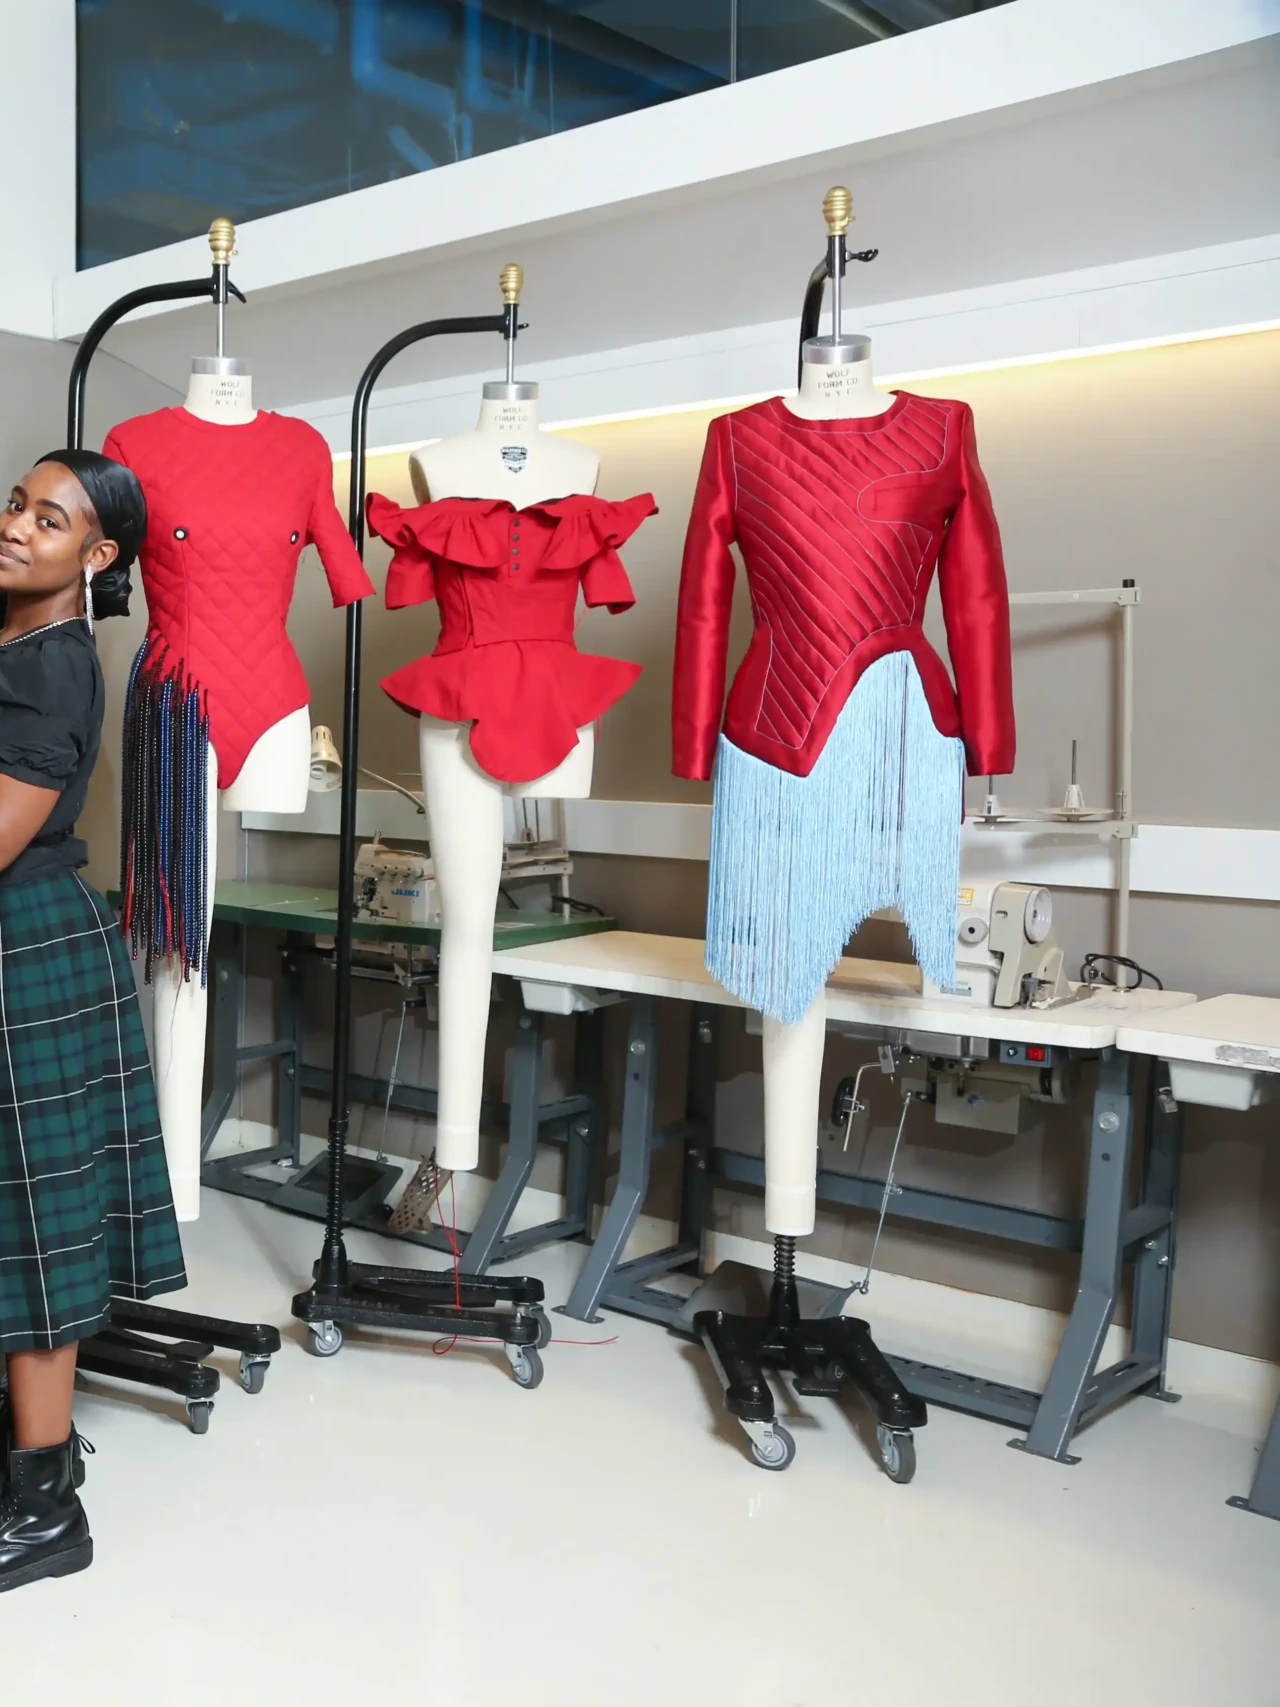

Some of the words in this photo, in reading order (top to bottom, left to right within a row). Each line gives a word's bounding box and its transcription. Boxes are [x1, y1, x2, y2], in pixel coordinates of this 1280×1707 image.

[826, 368, 851, 379] WOLF
[818, 380, 842, 390] FORM
[391, 888, 419, 897] JUKI
